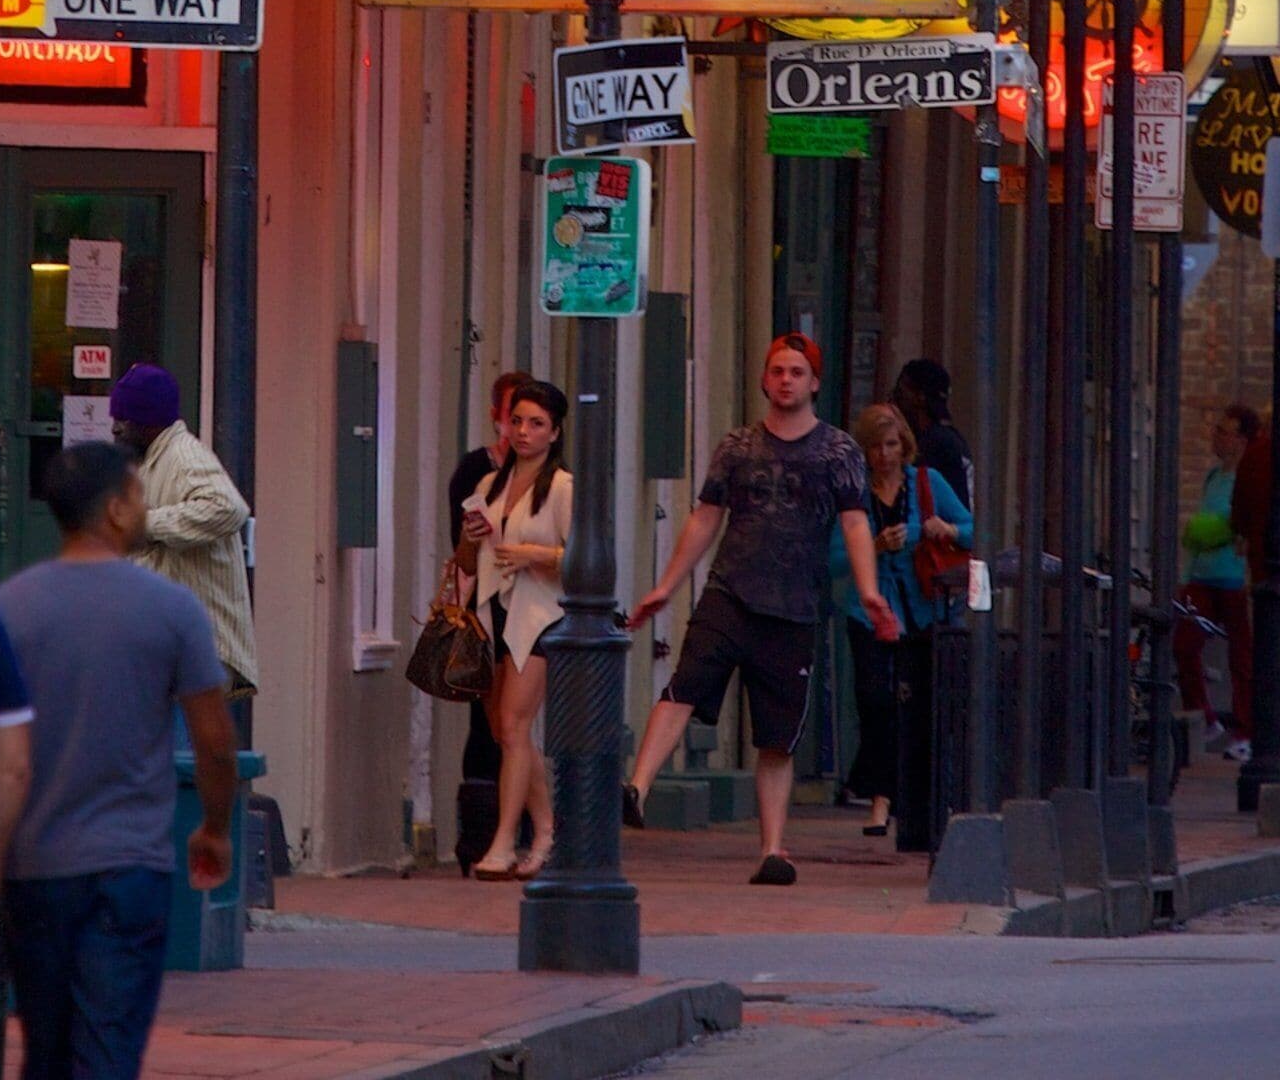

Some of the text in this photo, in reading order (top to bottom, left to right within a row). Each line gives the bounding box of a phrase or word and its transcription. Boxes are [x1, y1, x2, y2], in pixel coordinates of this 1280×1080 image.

[819, 46, 851, 60] Rue
[883, 43, 947, 58] Orleans
[571, 72, 678, 120] ONE WAY
[775, 62, 983, 108] Orleans
[1140, 150, 1168, 173] NE
[79, 349, 107, 364] ATM
